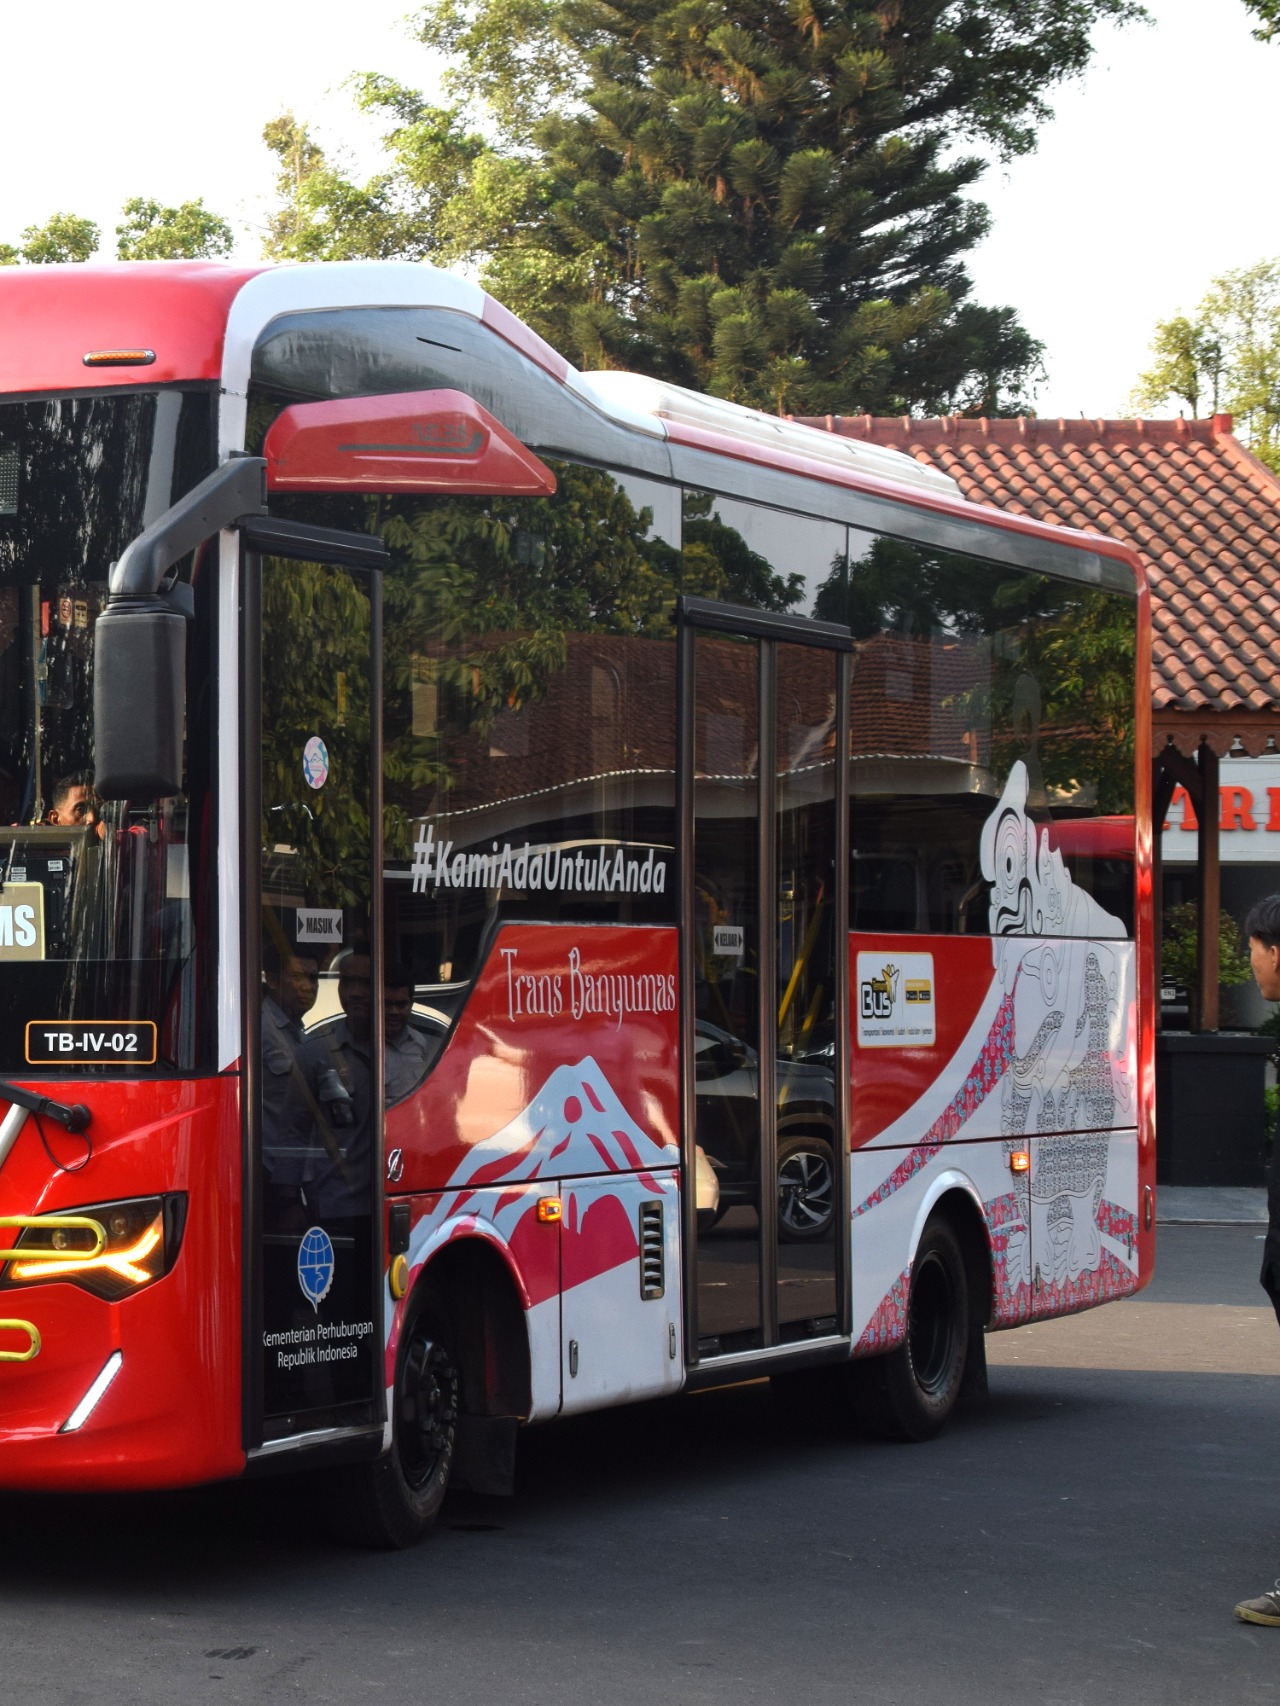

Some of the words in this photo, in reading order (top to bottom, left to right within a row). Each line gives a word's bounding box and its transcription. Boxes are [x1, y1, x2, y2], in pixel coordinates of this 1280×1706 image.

[411, 824, 667, 893] #KamiAdaUntukAnda
[306, 917, 333, 934] MASUK
[500, 948, 563, 1022] Trans
[568, 946, 676, 1032] Banyumas
[861, 982, 892, 1019] Bus
[44, 1033, 138, 1052] TB-IV-02
[317, 1321, 374, 1339] Perhubungan
[278, 1347, 316, 1371] Republik
[317, 1342, 358, 1362] Indonesia
